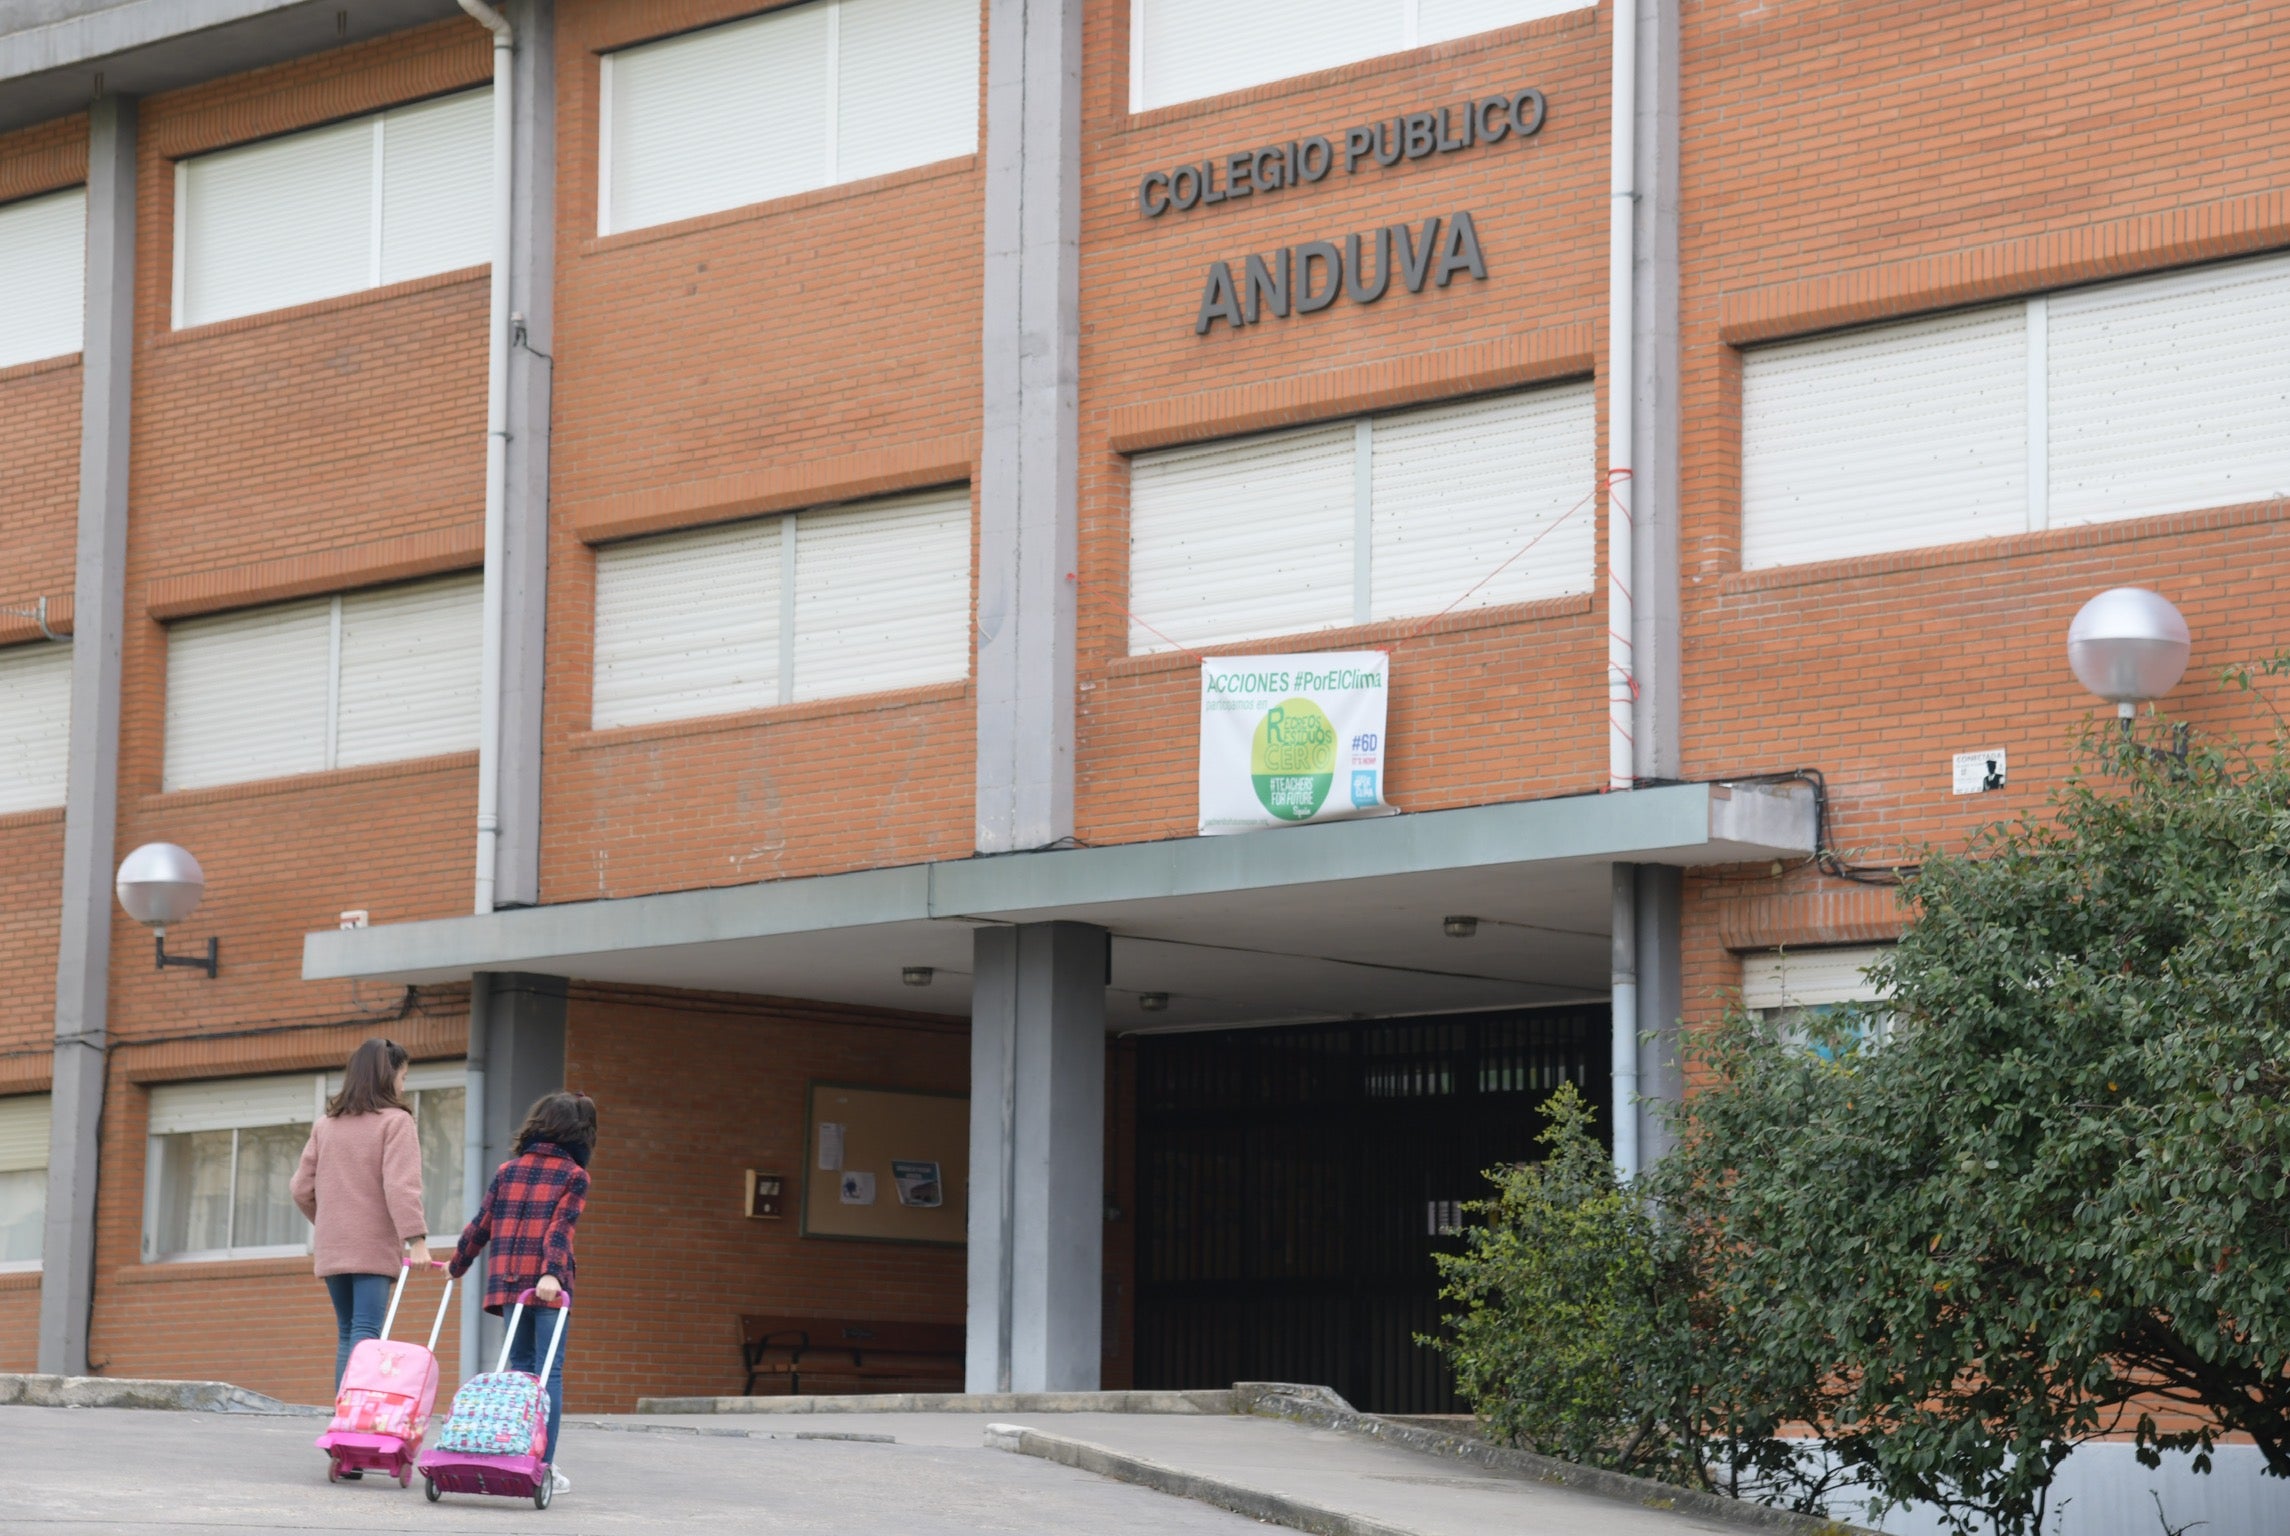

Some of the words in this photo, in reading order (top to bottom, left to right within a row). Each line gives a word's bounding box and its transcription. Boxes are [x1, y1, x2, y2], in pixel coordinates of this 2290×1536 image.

[1139, 135, 1334, 218] COLEGIO
[1345, 87, 1546, 174] PUBLICO
[1196, 210, 1487, 336] ANDUVA
[1207, 672, 1289, 693] ACCIONES
[1294, 669, 1382, 691] #PorElClima
[1352, 733, 1378, 752] #6D
[1264, 743, 1332, 771] CERO
